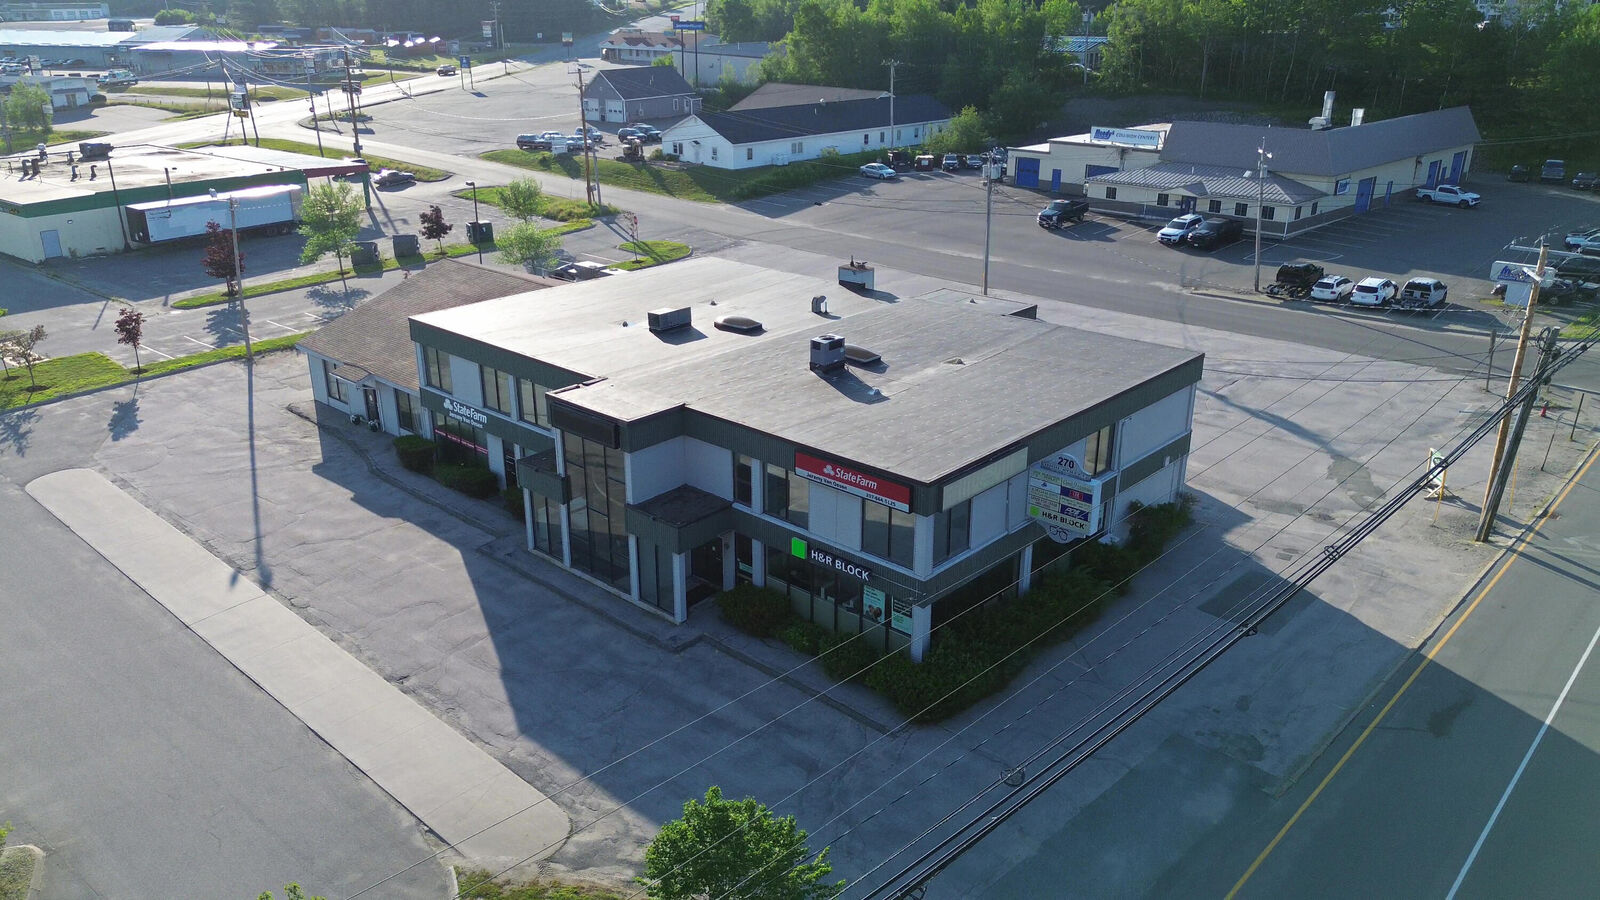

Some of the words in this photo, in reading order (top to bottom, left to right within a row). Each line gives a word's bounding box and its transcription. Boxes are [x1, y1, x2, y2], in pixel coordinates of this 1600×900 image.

[1057, 456, 1075, 469] 270
[1042, 511, 1058, 521] H&R
[1059, 517, 1085, 530] BLOCK
[811, 549, 832, 566] H&R
[835, 560, 871, 581] BLOCK
